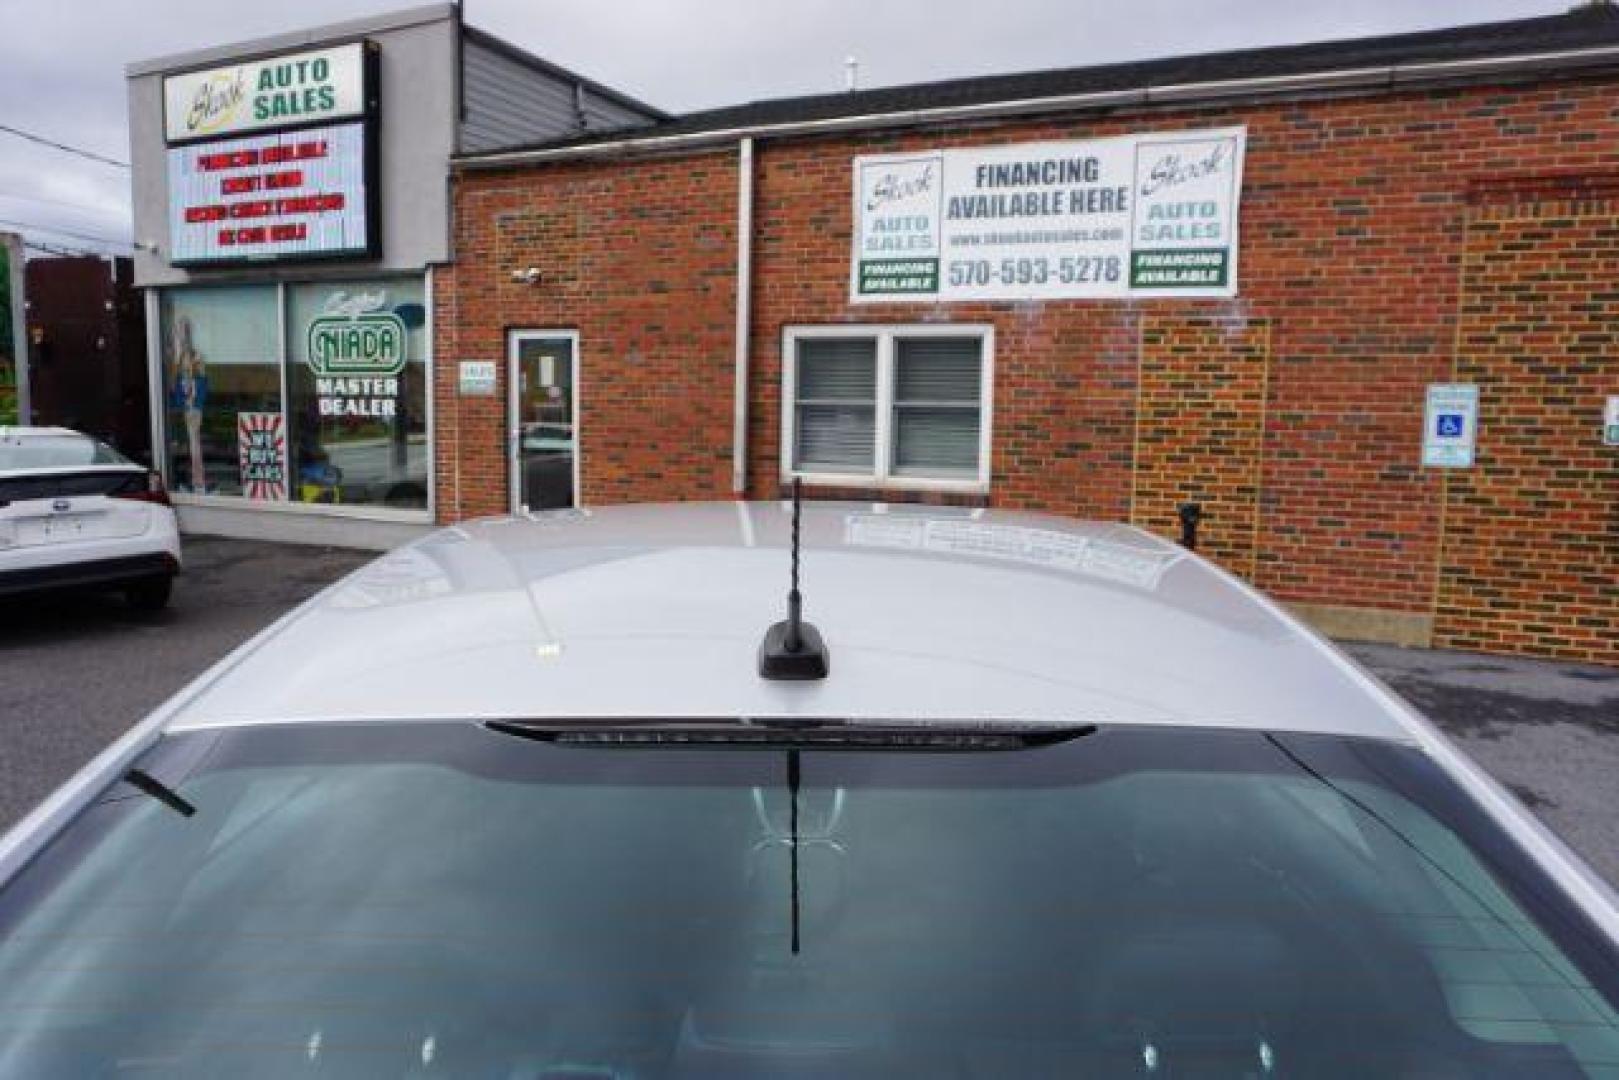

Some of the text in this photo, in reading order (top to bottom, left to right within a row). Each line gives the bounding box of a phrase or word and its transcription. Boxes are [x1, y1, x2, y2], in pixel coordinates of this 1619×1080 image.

[258, 58, 329, 91] AUTO
[253, 86, 335, 120] SALES
[975, 156, 1099, 188] FINANCING
[948, 186, 1129, 220] AVAILABLE HERE
[1147, 201, 1217, 221] AUTO
[873, 215, 929, 233] AUTO
[1140, 221, 1220, 241] SALES
[865, 234, 932, 251] SALES
[949, 254, 1122, 287] 570-593-5278
[317, 327, 394, 361] NIADA
[316, 378, 398, 396] MASTER
[318, 398, 396, 416] DEALER
